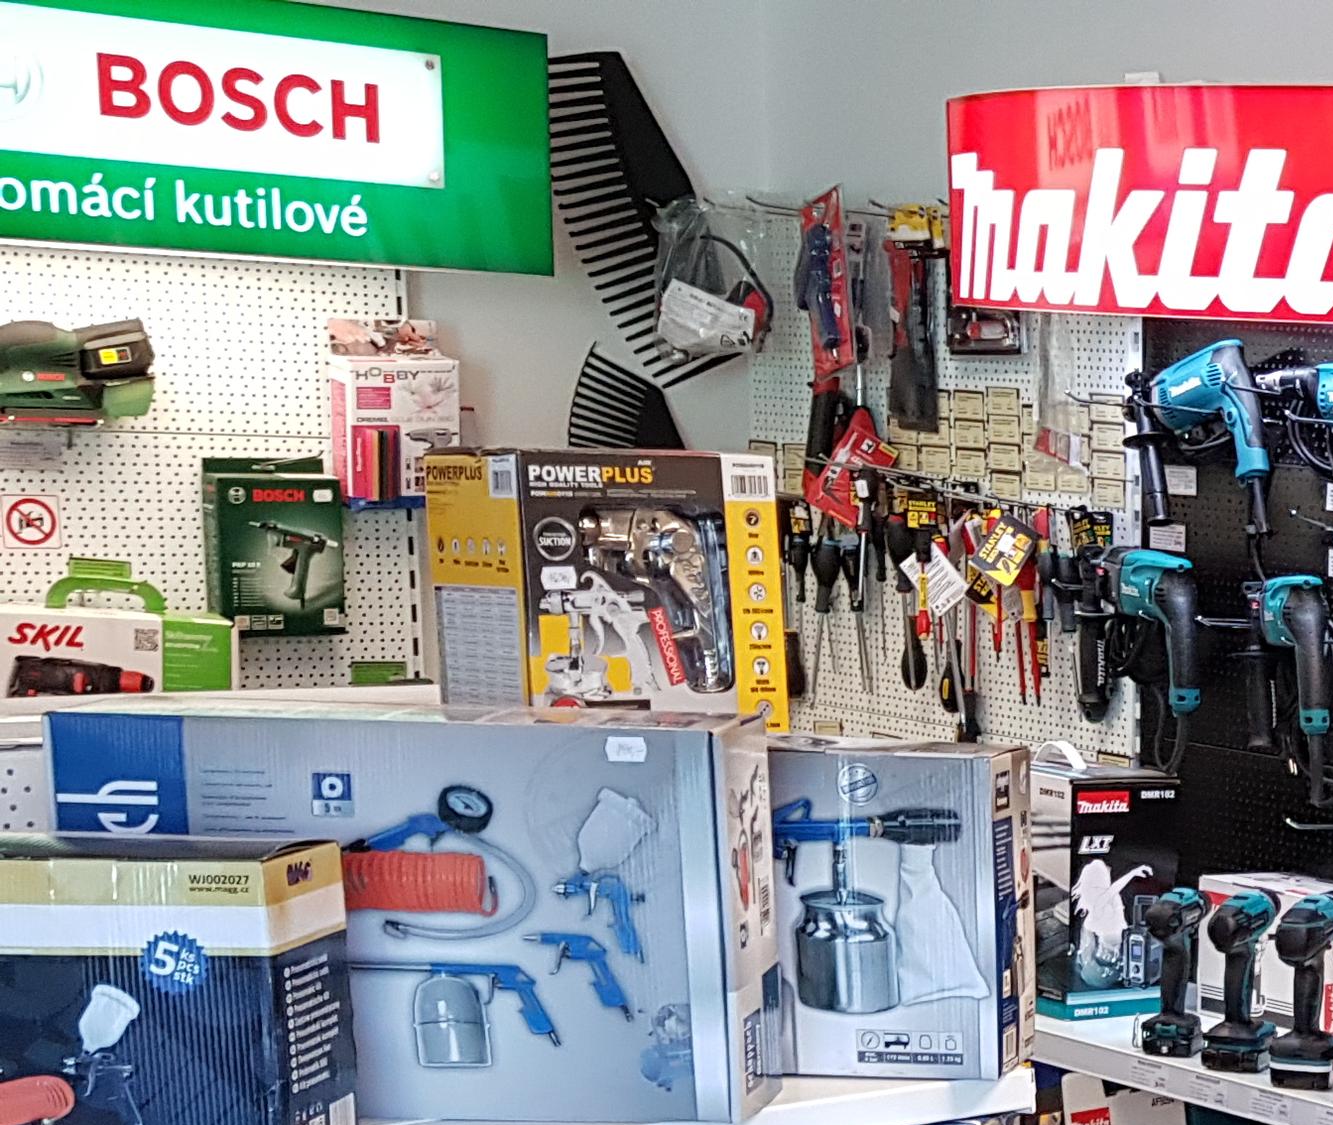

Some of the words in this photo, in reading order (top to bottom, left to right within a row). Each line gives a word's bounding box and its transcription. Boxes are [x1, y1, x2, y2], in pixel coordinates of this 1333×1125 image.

[96, 51, 380, 144] BOSCH
[175, 178, 368, 238] kutilové
[355, 367, 420, 383] HOBBY
[426, 465, 483, 481] POWERPLUS
[528, 464, 653, 484] POWERPLUS
[252, 489, 305, 502] BOSCH
[538, 536, 572, 547] SUCTION
[979, 522, 1005, 559] STANLEY
[8, 623, 85, 651] SKIL
[652, 610, 684, 684] PROFESSIONAL
[1076, 800, 1129, 814] makita
[1080, 835, 1113, 853] LXT
[150, 941, 179, 976] 5
[177, 960, 201, 974] pcs
[174, 972, 194, 985] stk
